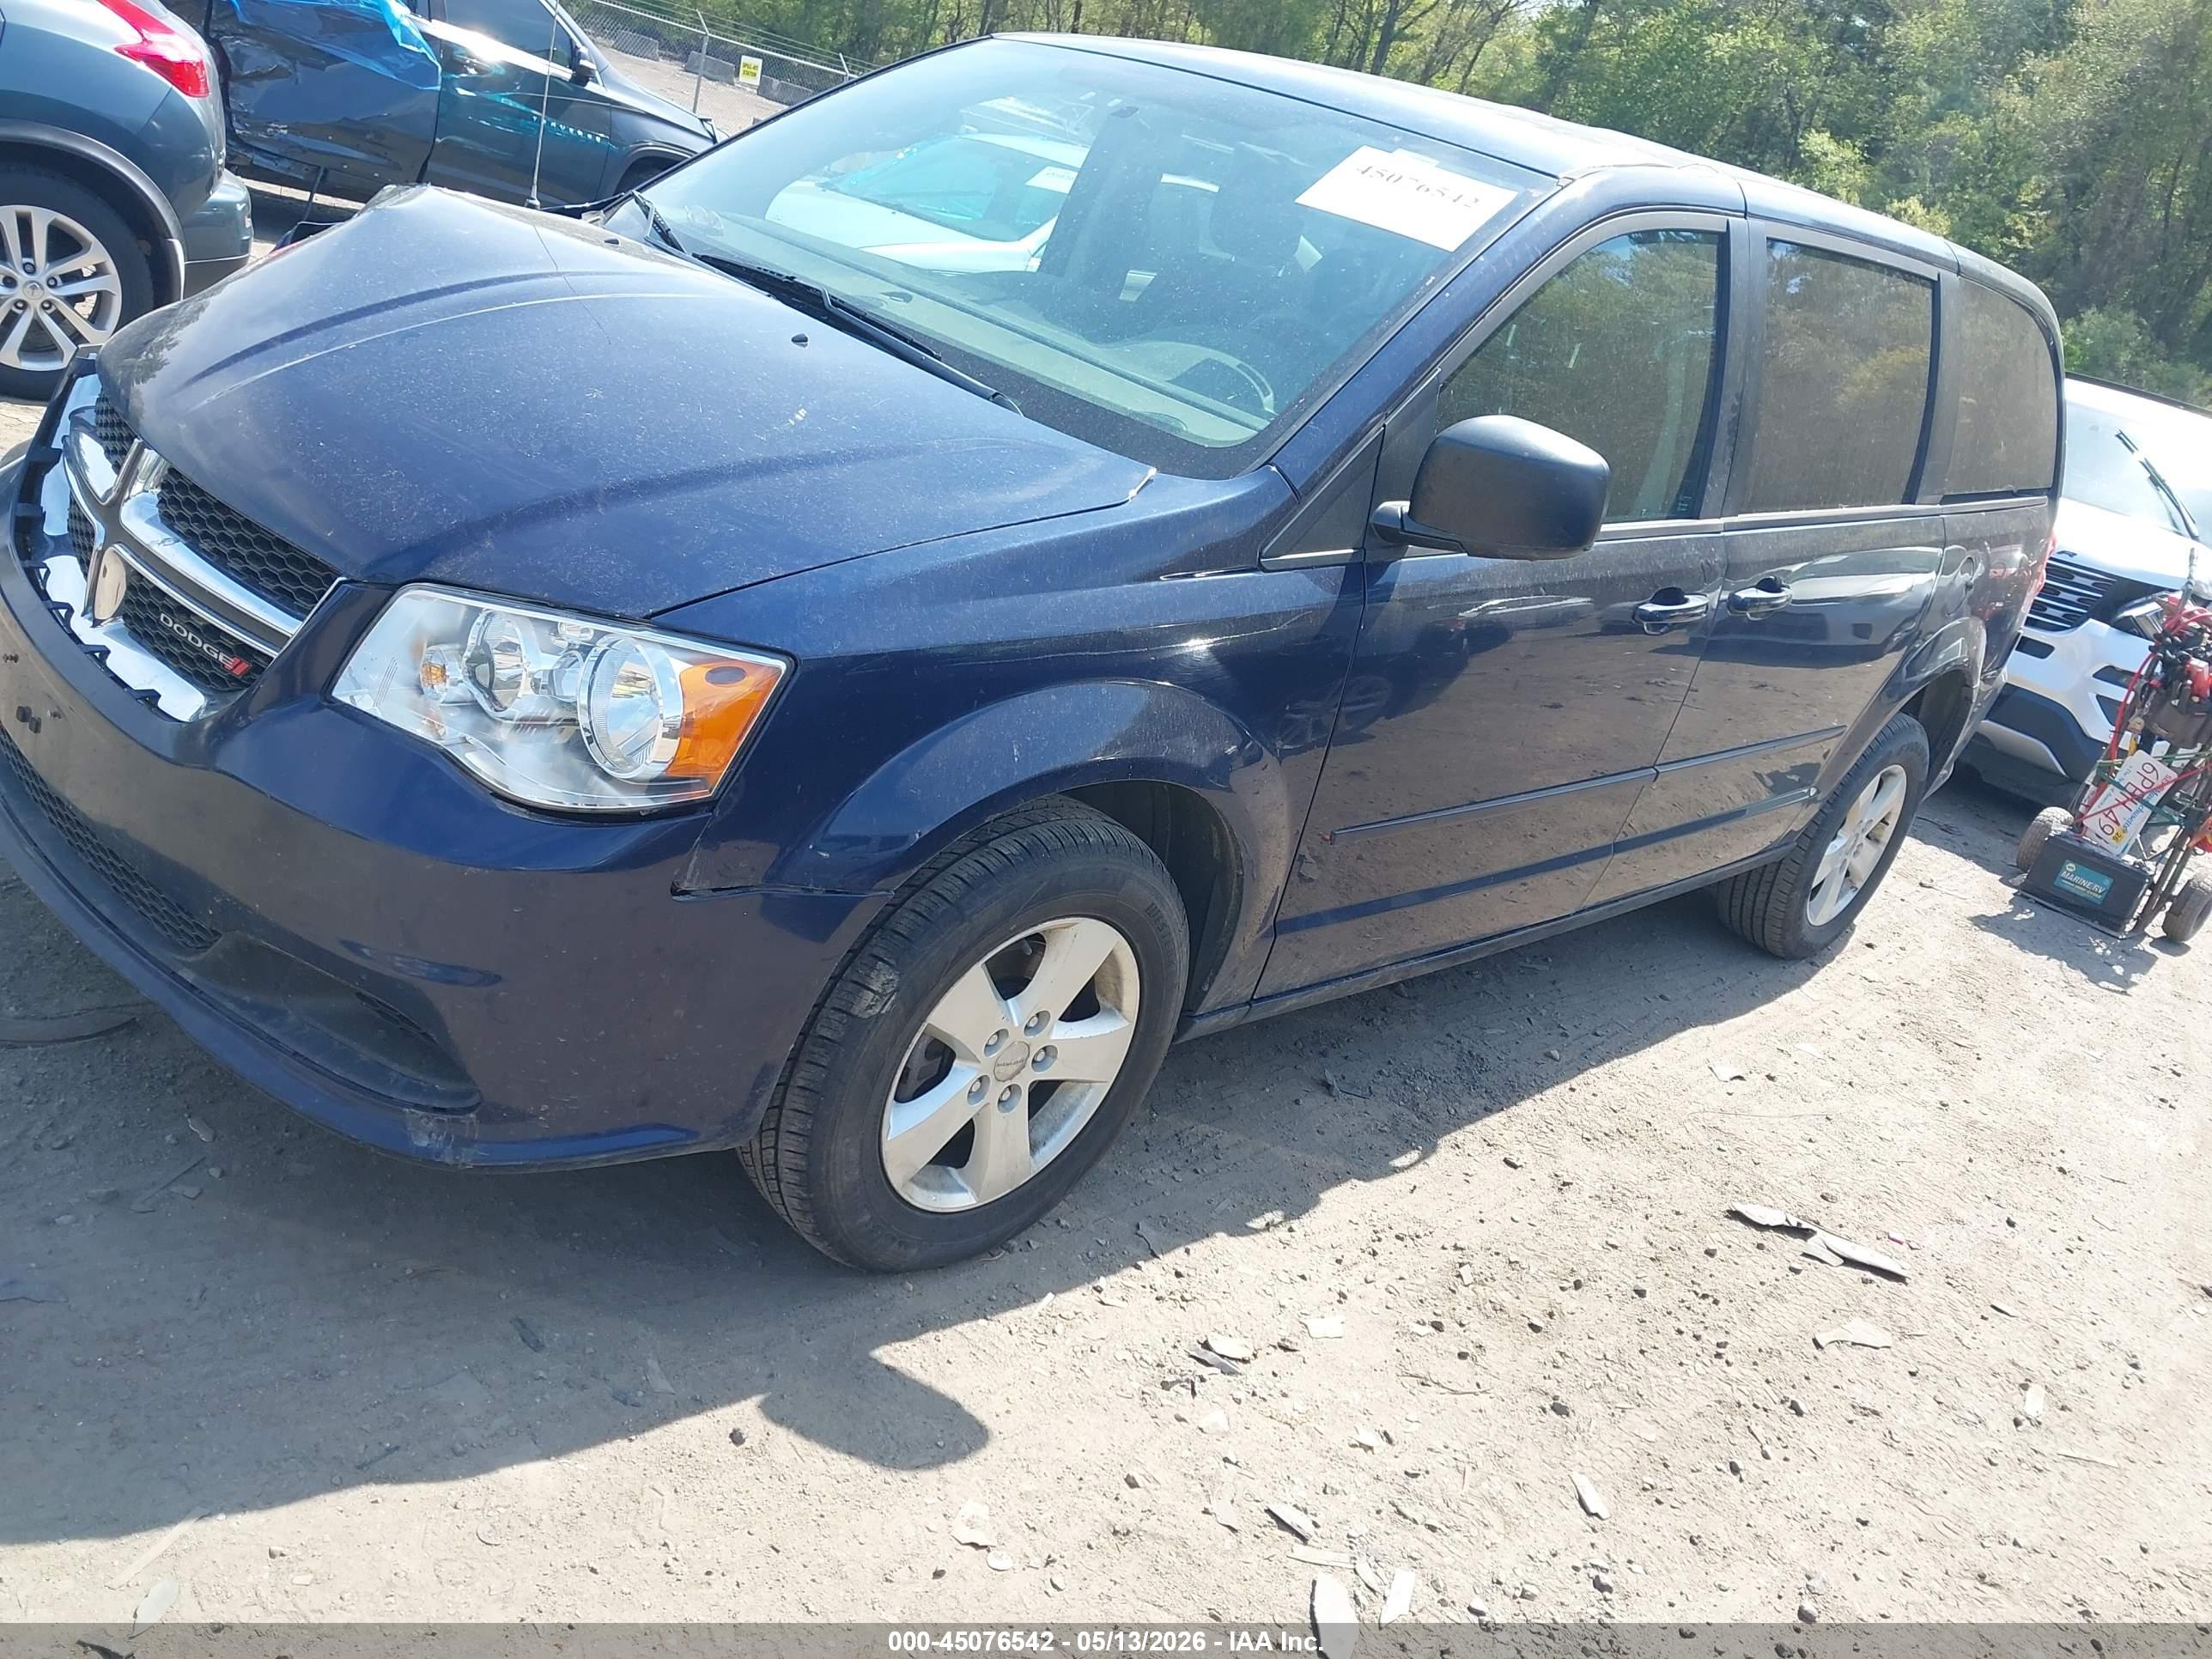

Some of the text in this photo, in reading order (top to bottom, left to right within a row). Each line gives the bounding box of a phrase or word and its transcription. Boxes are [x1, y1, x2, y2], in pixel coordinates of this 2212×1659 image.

[160, 612, 234, 671] DODGE
[2099, 809, 2120, 836] 49
[2061, 871, 2094, 889] MARINE
